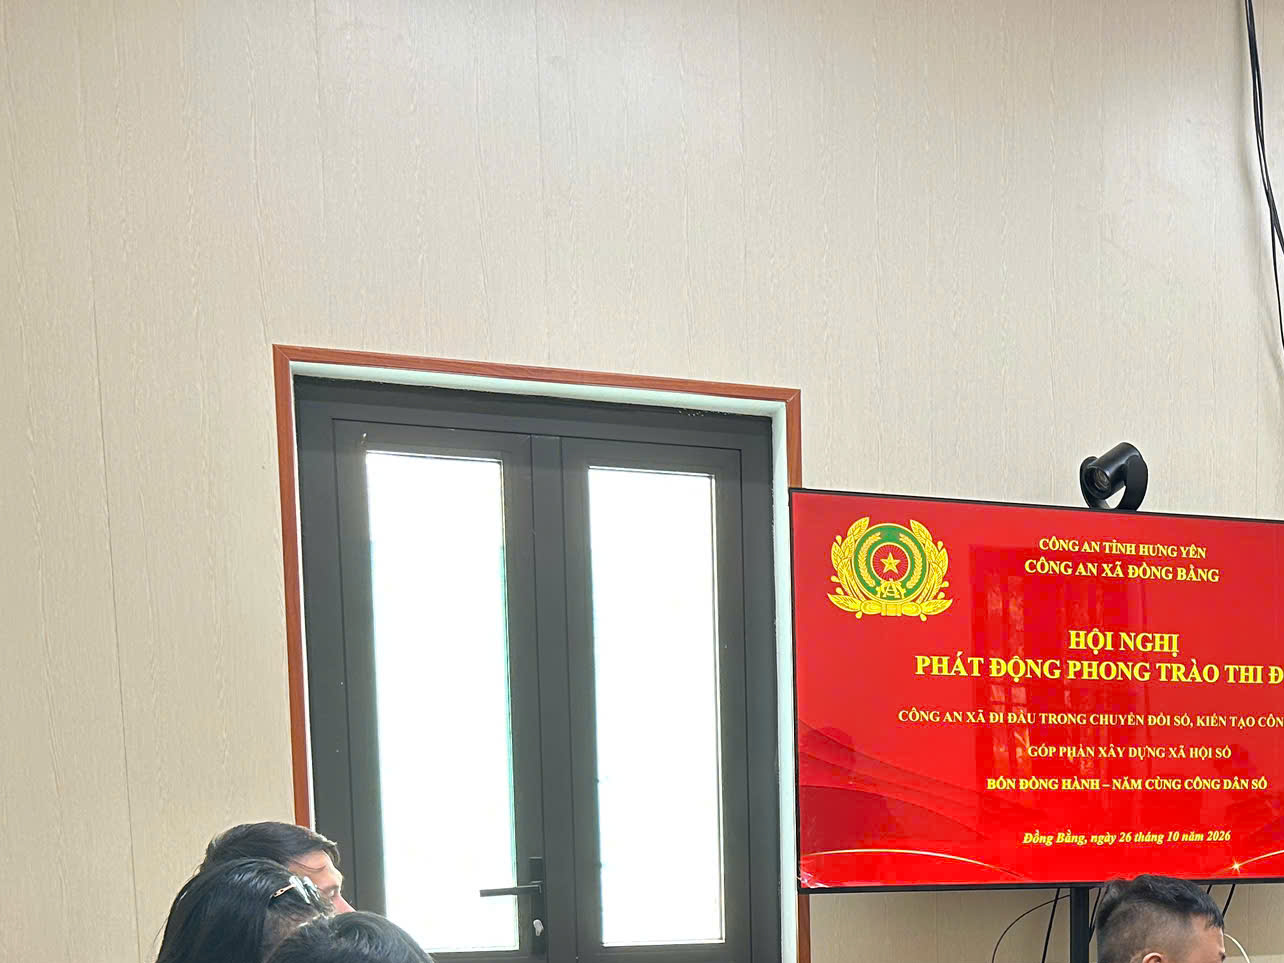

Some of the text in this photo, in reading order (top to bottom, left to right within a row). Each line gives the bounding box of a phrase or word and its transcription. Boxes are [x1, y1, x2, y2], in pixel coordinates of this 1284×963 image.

[1039, 535, 1079, 552] CÔNG
[1080, 541, 1100, 553] AN
[1138, 543, 1177, 558] HƯNG
[1179, 543, 1206, 559] YÊN
[1024, 556, 1072, 575] CÔNG
[1074, 562, 1097, 577] AN
[1101, 560, 1124, 578] XÃ
[1068, 627, 1179, 657] HỘI NGHỊ
[914, 650, 984, 677] PHÁT
[988, 655, 1061, 683] ĐỘNG
[1066, 660, 1151, 682] PHONG
[1155, 658, 1220, 683] TRÀO
[1224, 664, 1263, 684] THI
[898, 707, 939, 723] CÔNG
[942, 711, 962, 723] AN
[965, 709, 985, 723] XÃ
[989, 711, 1003, 724] ĐI
[1038, 712, 1086, 725] TRONG
[1229, 716, 1255, 730] TẠO
[1027, 743, 1057, 757] GÓP
[1098, 743, 1126, 757] XÂY
[1129, 745, 1166, 760] DỰNG
[1168, 745, 1187, 759] XÃ
[1189, 746, 1212, 760] HỘI
[1061, 775, 1100, 790] HÀNH
[1111, 775, 1142, 790] NĂM
[1144, 775, 1181, 791] CÙNG
[1183, 775, 1220, 790] CÔNG
[1223, 775, 1248, 790] DÂN
[1022, 829, 1054, 846] Đồng
[1090, 831, 1116, 846] ngày
[1118, 831, 1132, 843] 26
[1133, 831, 1164, 845] tháng
[1166, 831, 1179, 842] 10
[1181, 831, 1204, 842] năm
[1206, 830, 1231, 842] 2026
